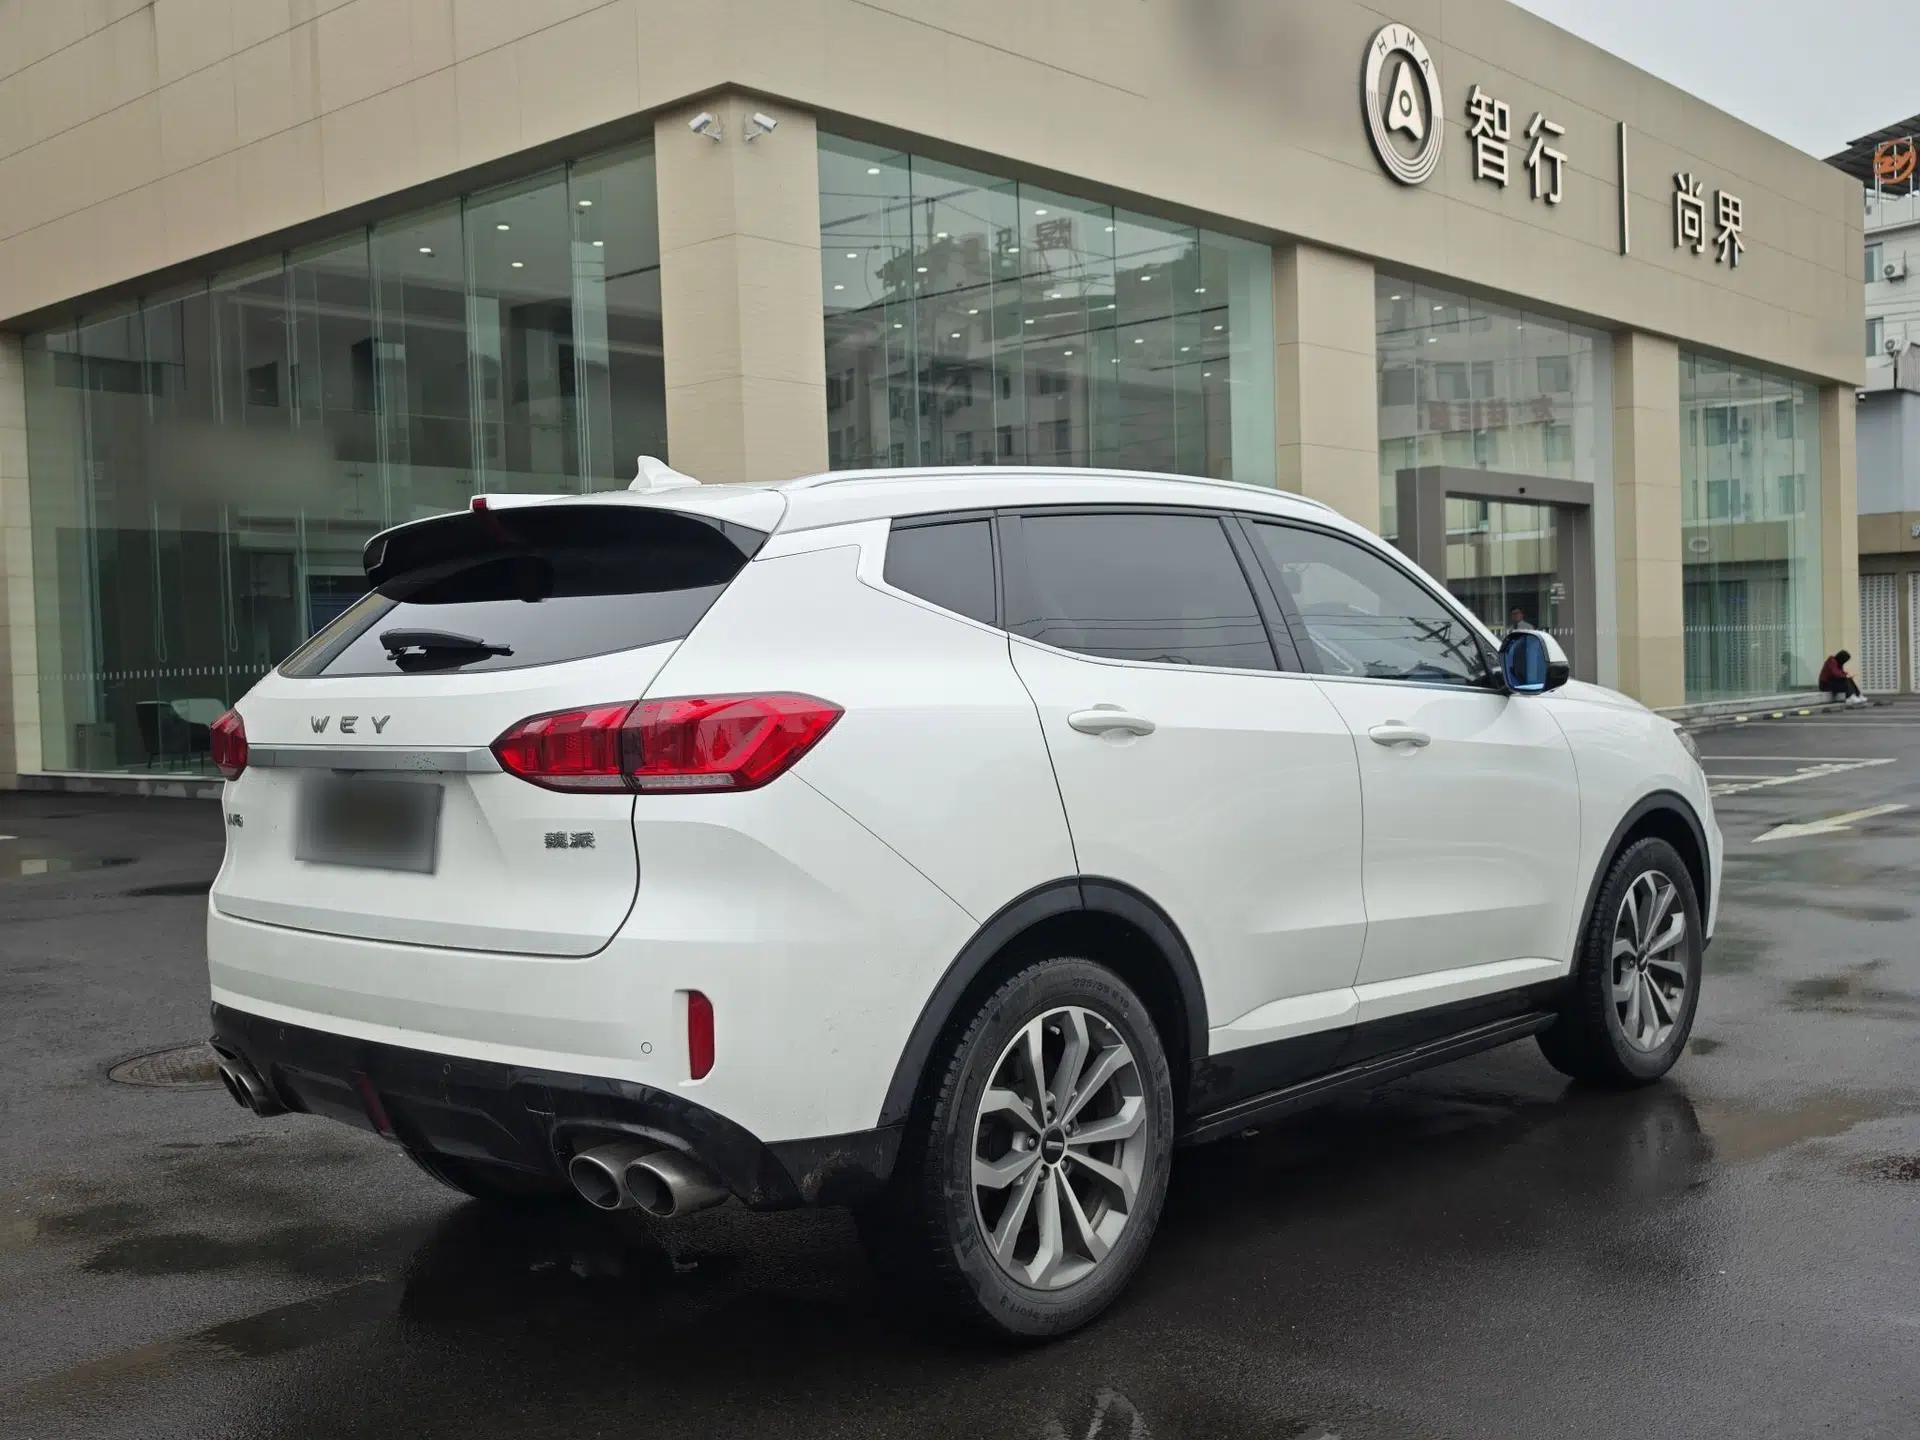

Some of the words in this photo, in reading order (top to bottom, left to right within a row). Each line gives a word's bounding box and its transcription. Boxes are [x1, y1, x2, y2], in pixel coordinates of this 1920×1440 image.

[1377, 27, 1429, 75] HIMA
[1467, 84, 1568, 203] 智行
[1674, 172, 1744, 268] 尚界
[311, 715, 391, 734] WEY
